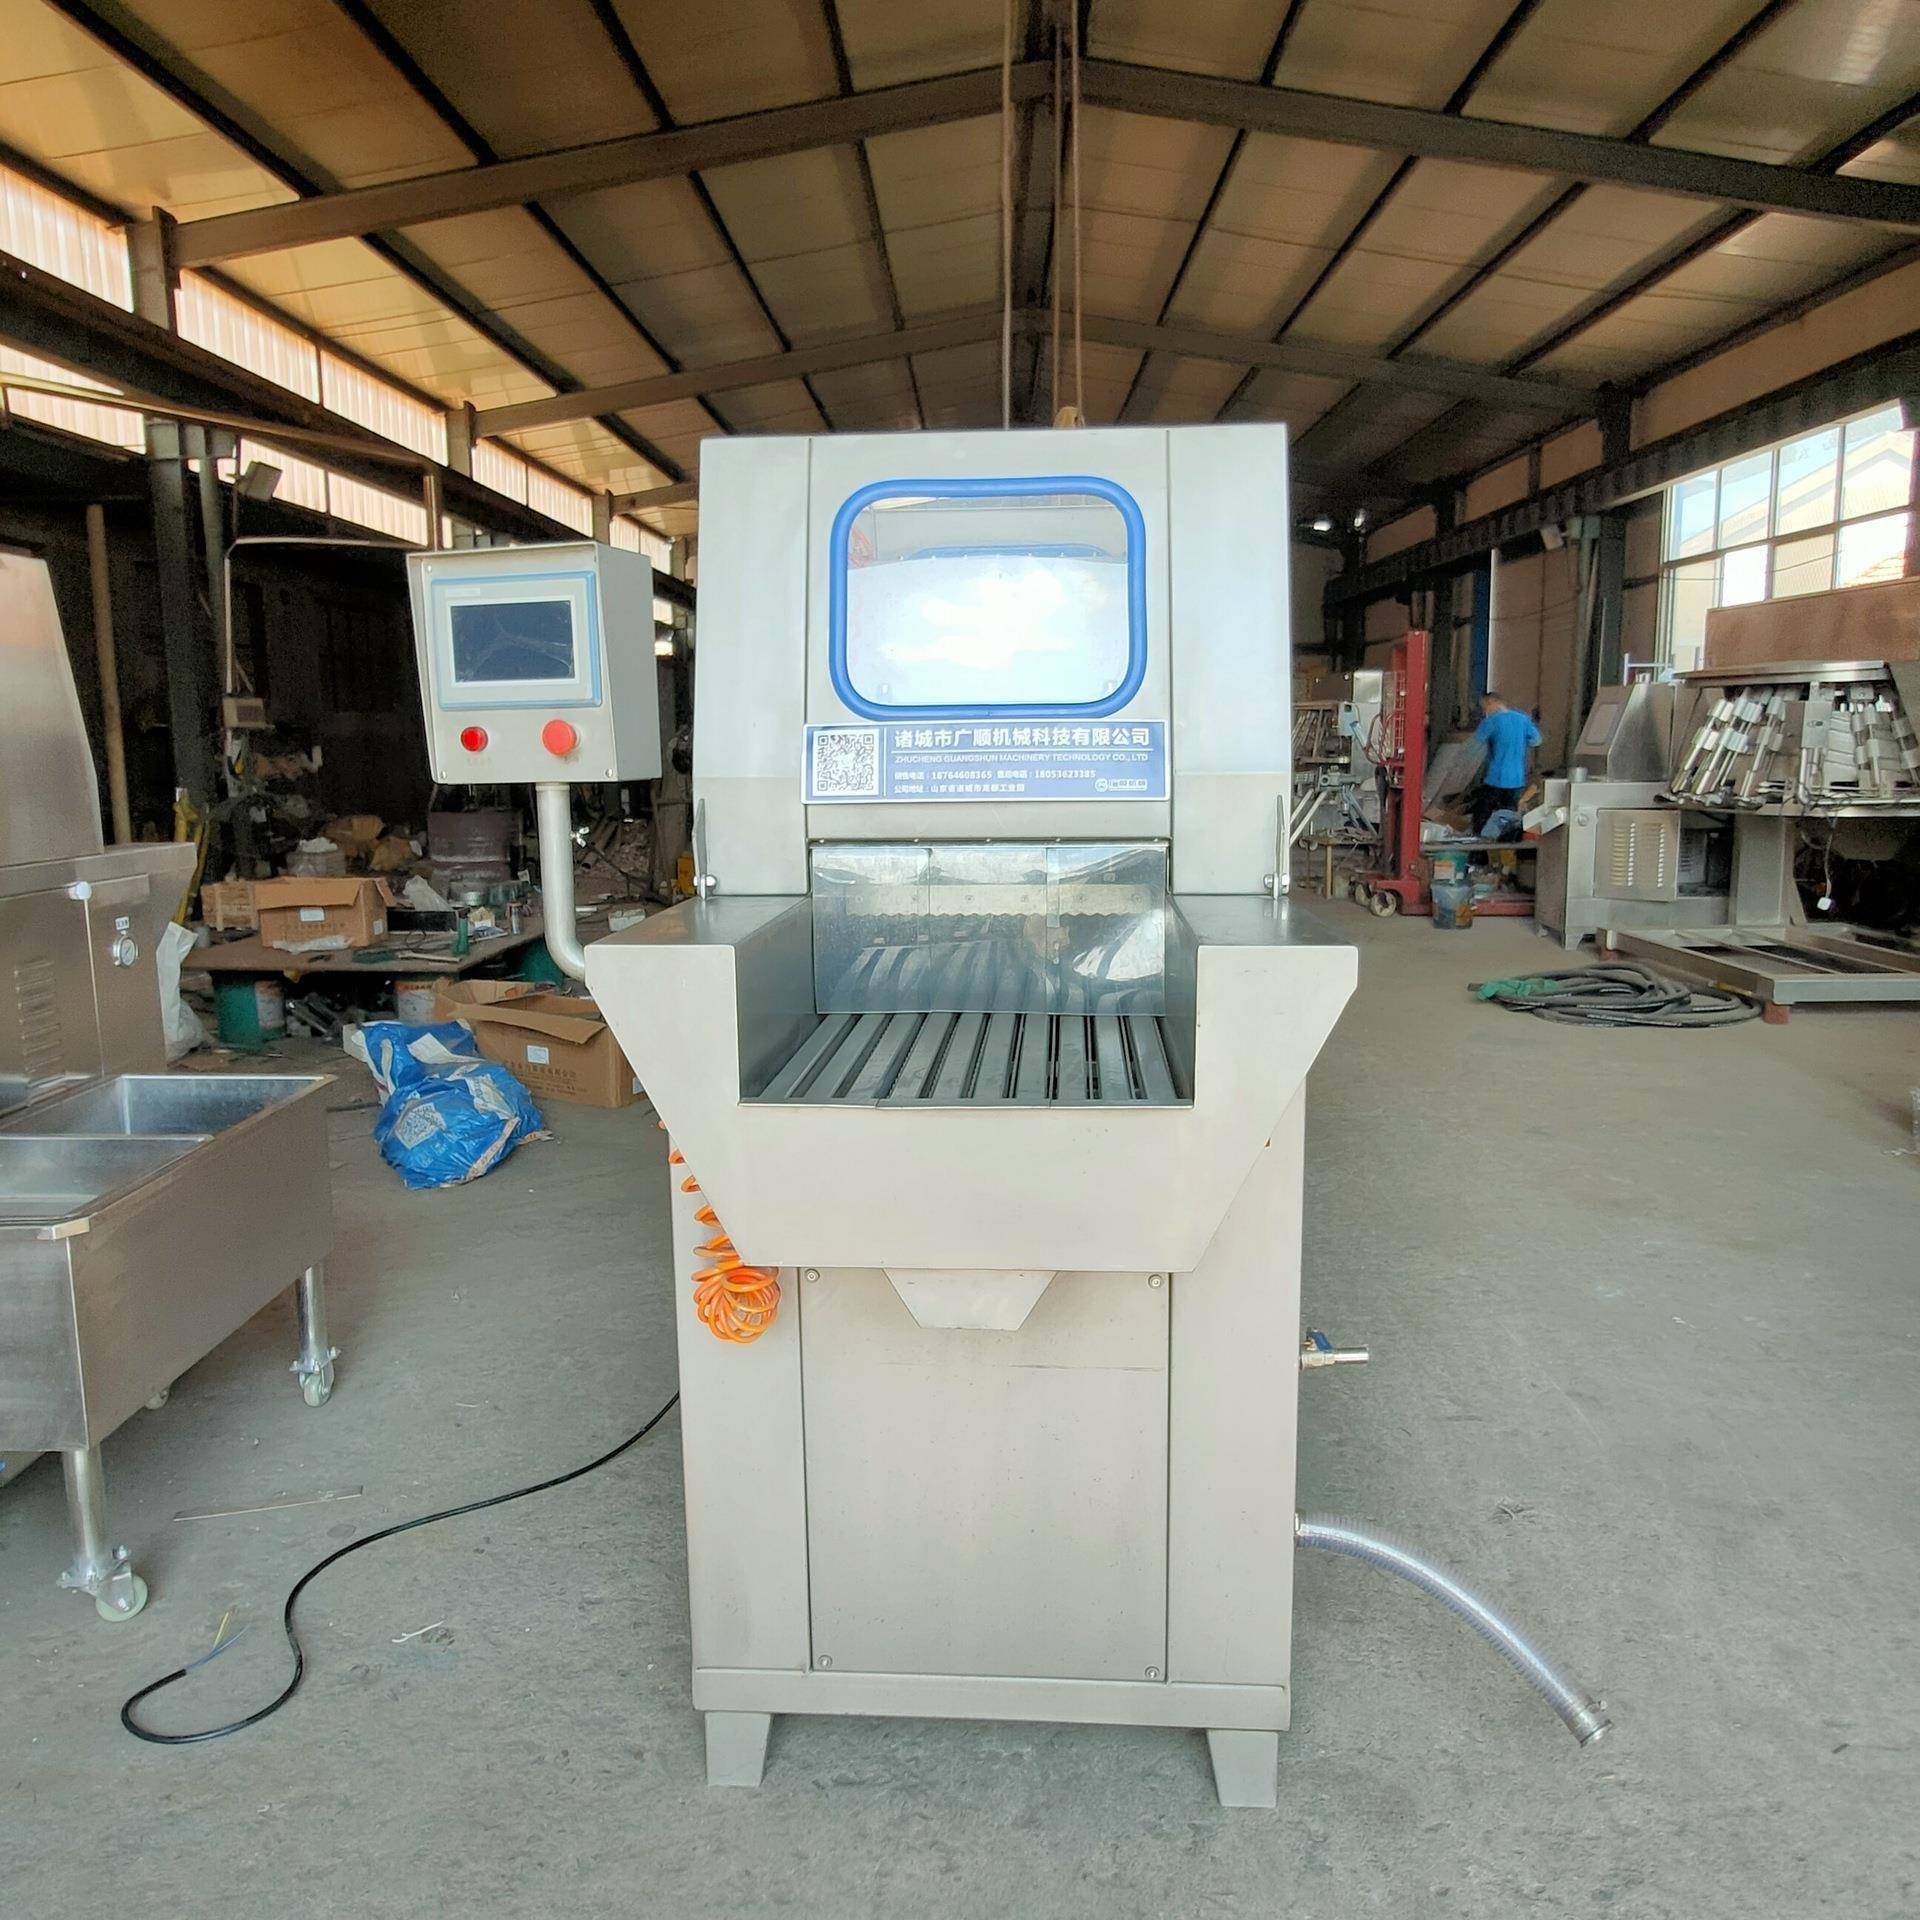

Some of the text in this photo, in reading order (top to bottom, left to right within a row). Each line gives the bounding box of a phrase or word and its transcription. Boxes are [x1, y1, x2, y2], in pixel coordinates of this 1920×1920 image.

[894, 728, 1150, 748] 诸城市广顺机械科技有限公司
[894, 755, 943, 763] ZHUCHENG
[943, 754, 998, 762] GUANGSHUN
[999, 753, 1050, 762] MACHINERY
[1052, 753, 1111, 762] TECHNOLOGY
